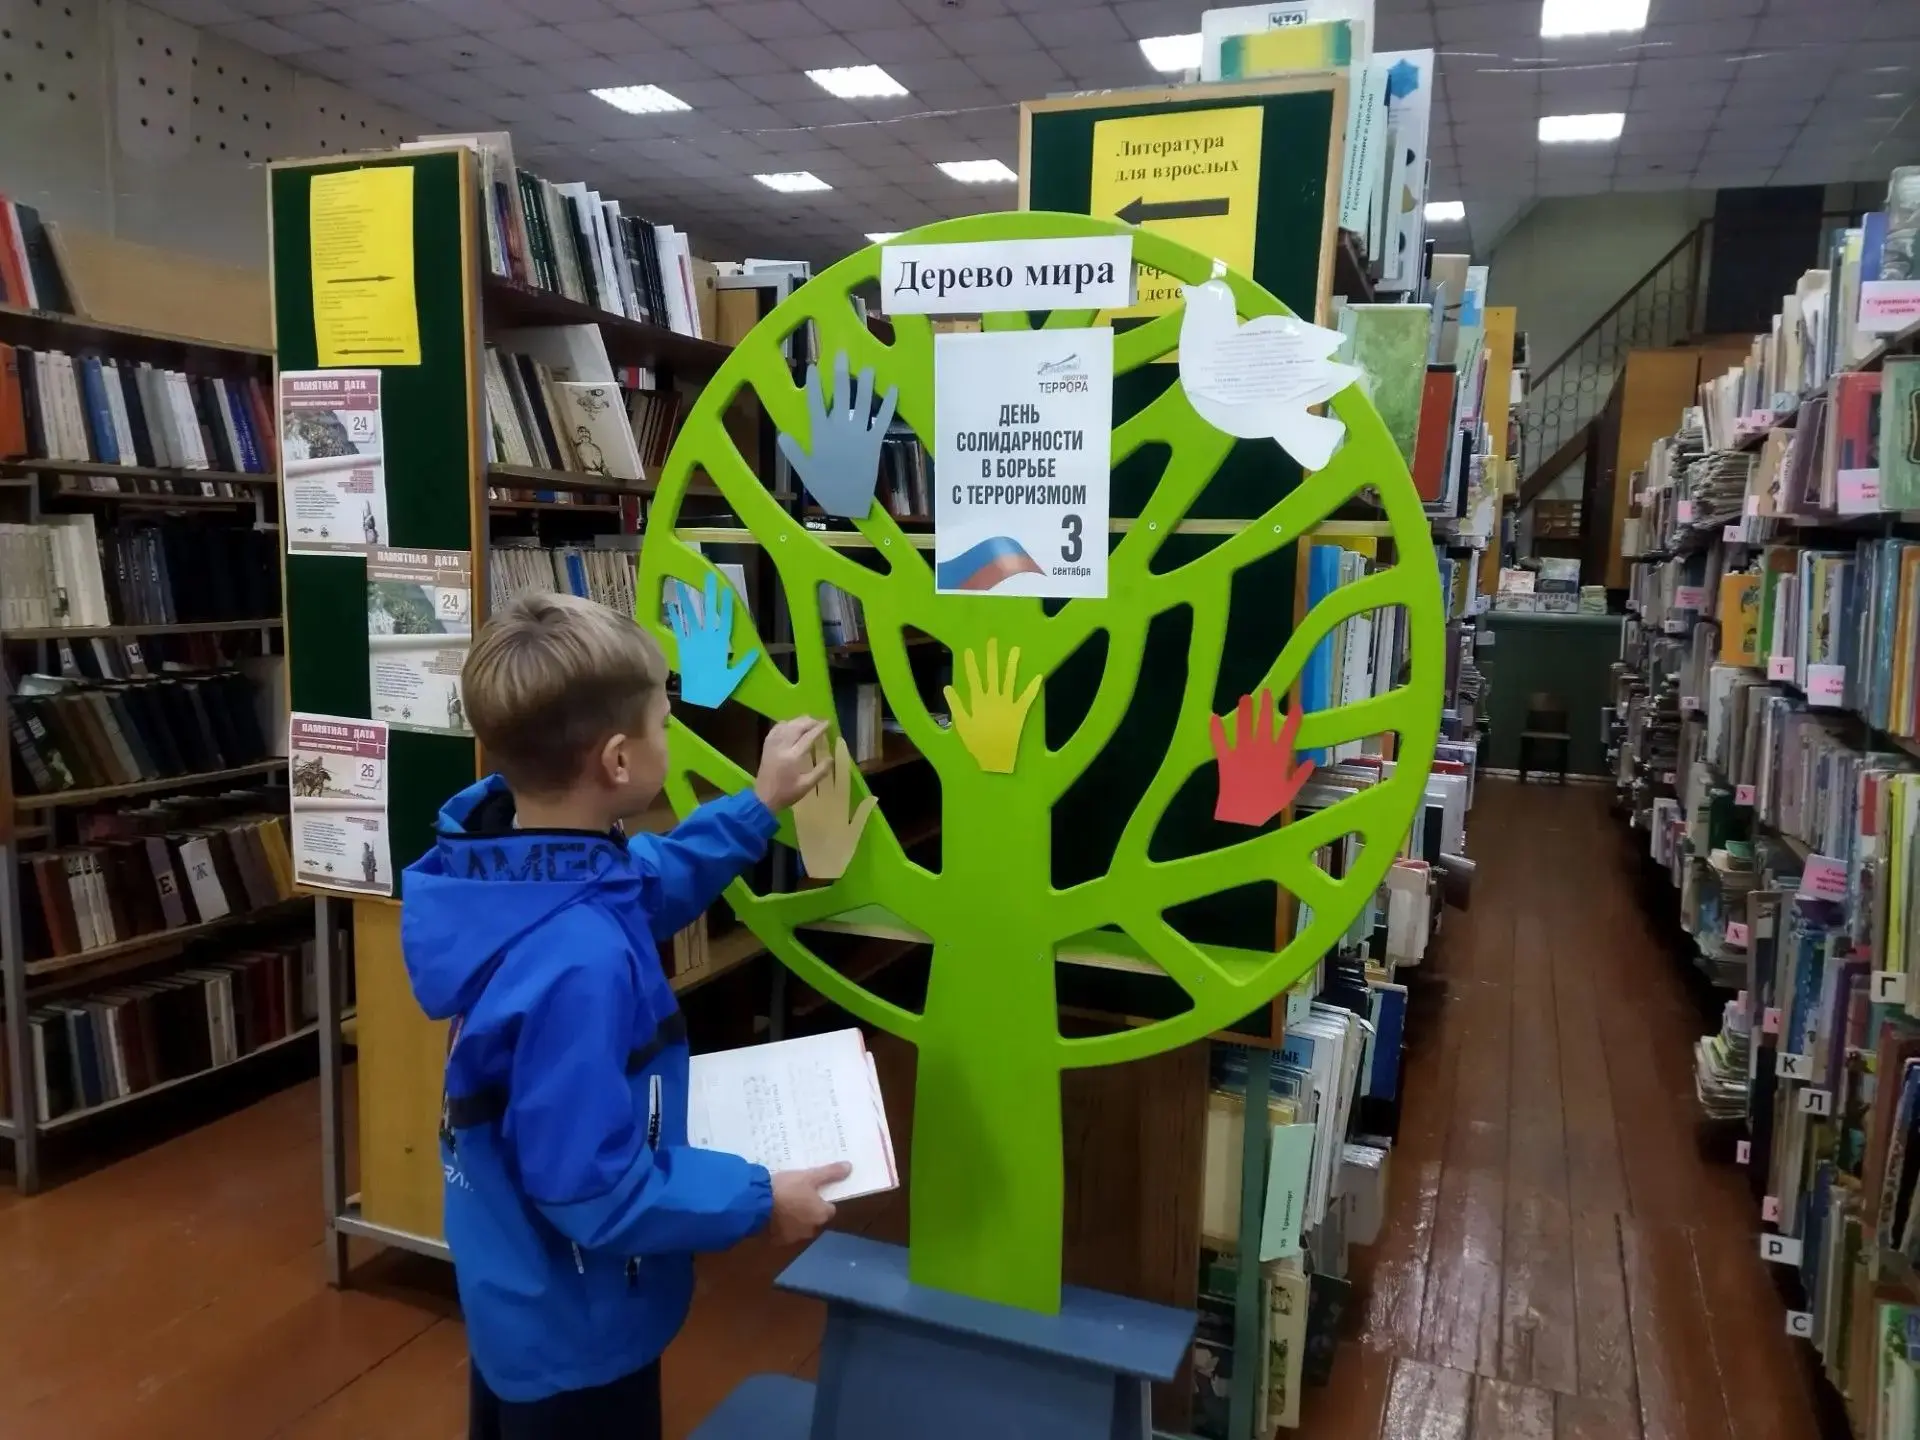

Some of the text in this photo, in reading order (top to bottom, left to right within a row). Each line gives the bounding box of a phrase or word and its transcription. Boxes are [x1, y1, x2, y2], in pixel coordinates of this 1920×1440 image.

[1116, 136, 1224, 157] Литература
[1115, 160, 1239, 183] для взрослых
[894, 260, 1115, 297] Дерево мира
[293, 380, 366, 391] ПАМЯТНАЯ ДАТА
[1039, 381, 1088, 393] ТЕРРОРА
[353, 416, 367, 430] 24
[999, 404, 1040, 426] ДЕНЬ
[956, 430, 1083, 453] СОЛИДАРНОСТИ
[981, 458, 1056, 478] В БОРЬБЕ
[952, 485, 1086, 505] С ТЕРРОРИЗМОМ
[1061, 514, 1083, 563] 3
[377, 551, 459, 567] ПАМЯТНАЯ ДАТА
[1052, 566, 1091, 577] сентября
[442, 594, 460, 610] 24
[301, 723, 375, 739] ПАМЯТНАЯ ДАТА
[361, 763, 374, 778] 26
[1881, 976, 1897, 997] Г
[1783, 1056, 1797, 1073] К
[1805, 1093, 1823, 1111] Л
[1769, 1240, 1783, 1256] Р
[1793, 1316, 1807, 1331] С
